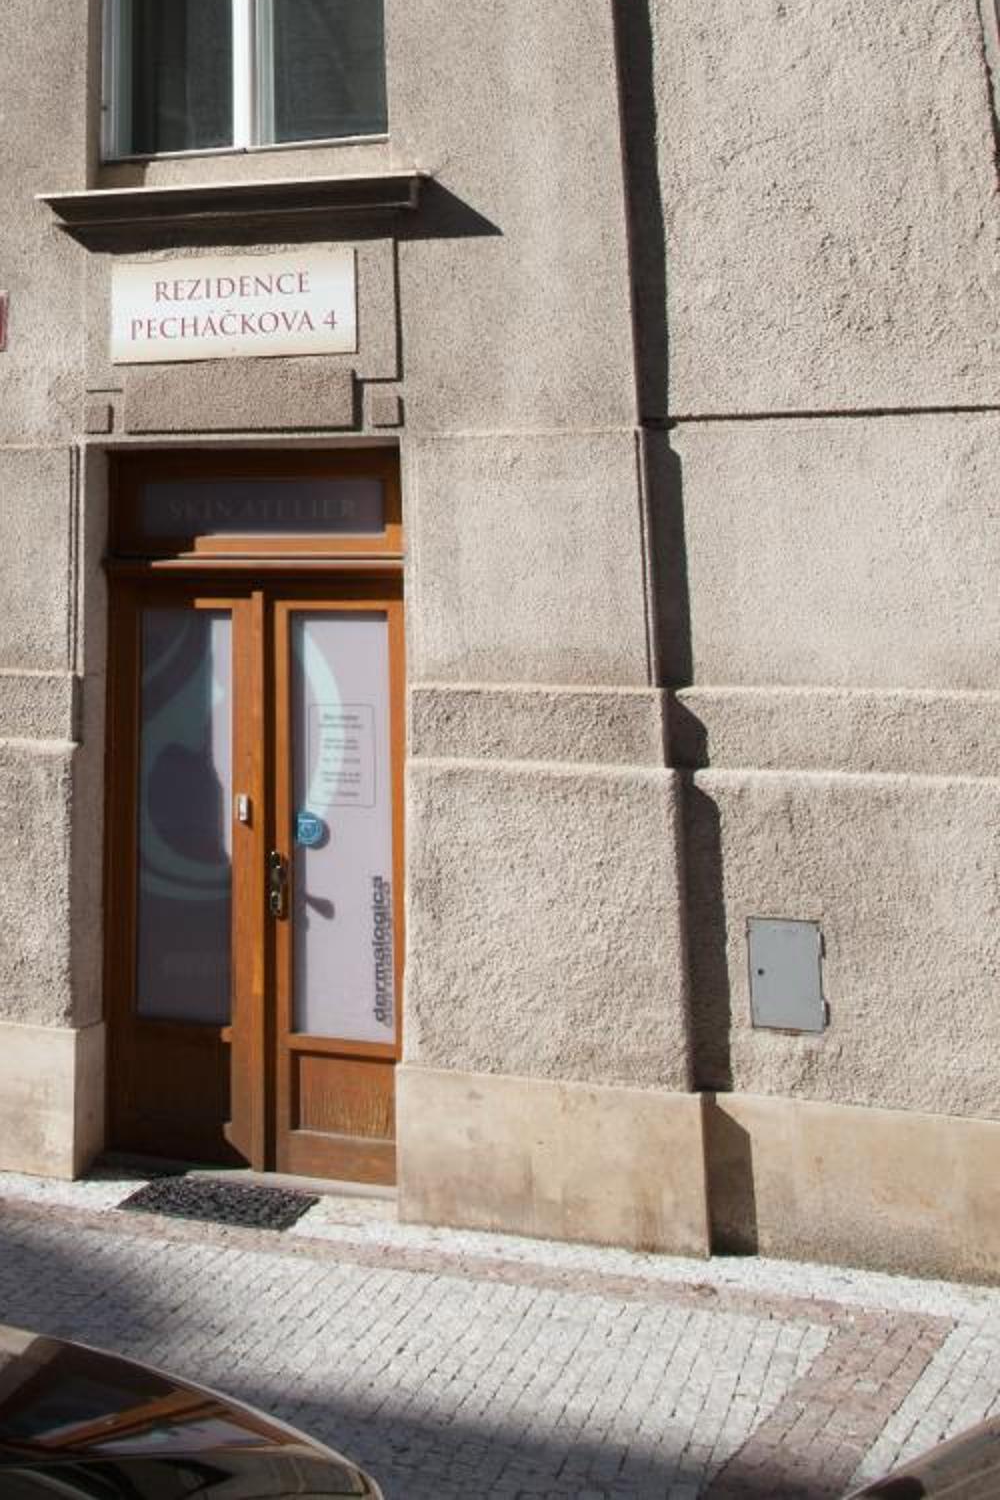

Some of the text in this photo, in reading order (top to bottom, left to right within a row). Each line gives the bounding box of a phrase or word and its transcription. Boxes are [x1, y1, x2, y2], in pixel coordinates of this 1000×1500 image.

[154, 271, 310, 303] REZIDENCE
[130, 308, 339, 341] PECHÁČKOVA 4
[370, 875, 387, 1022] dermalogica
